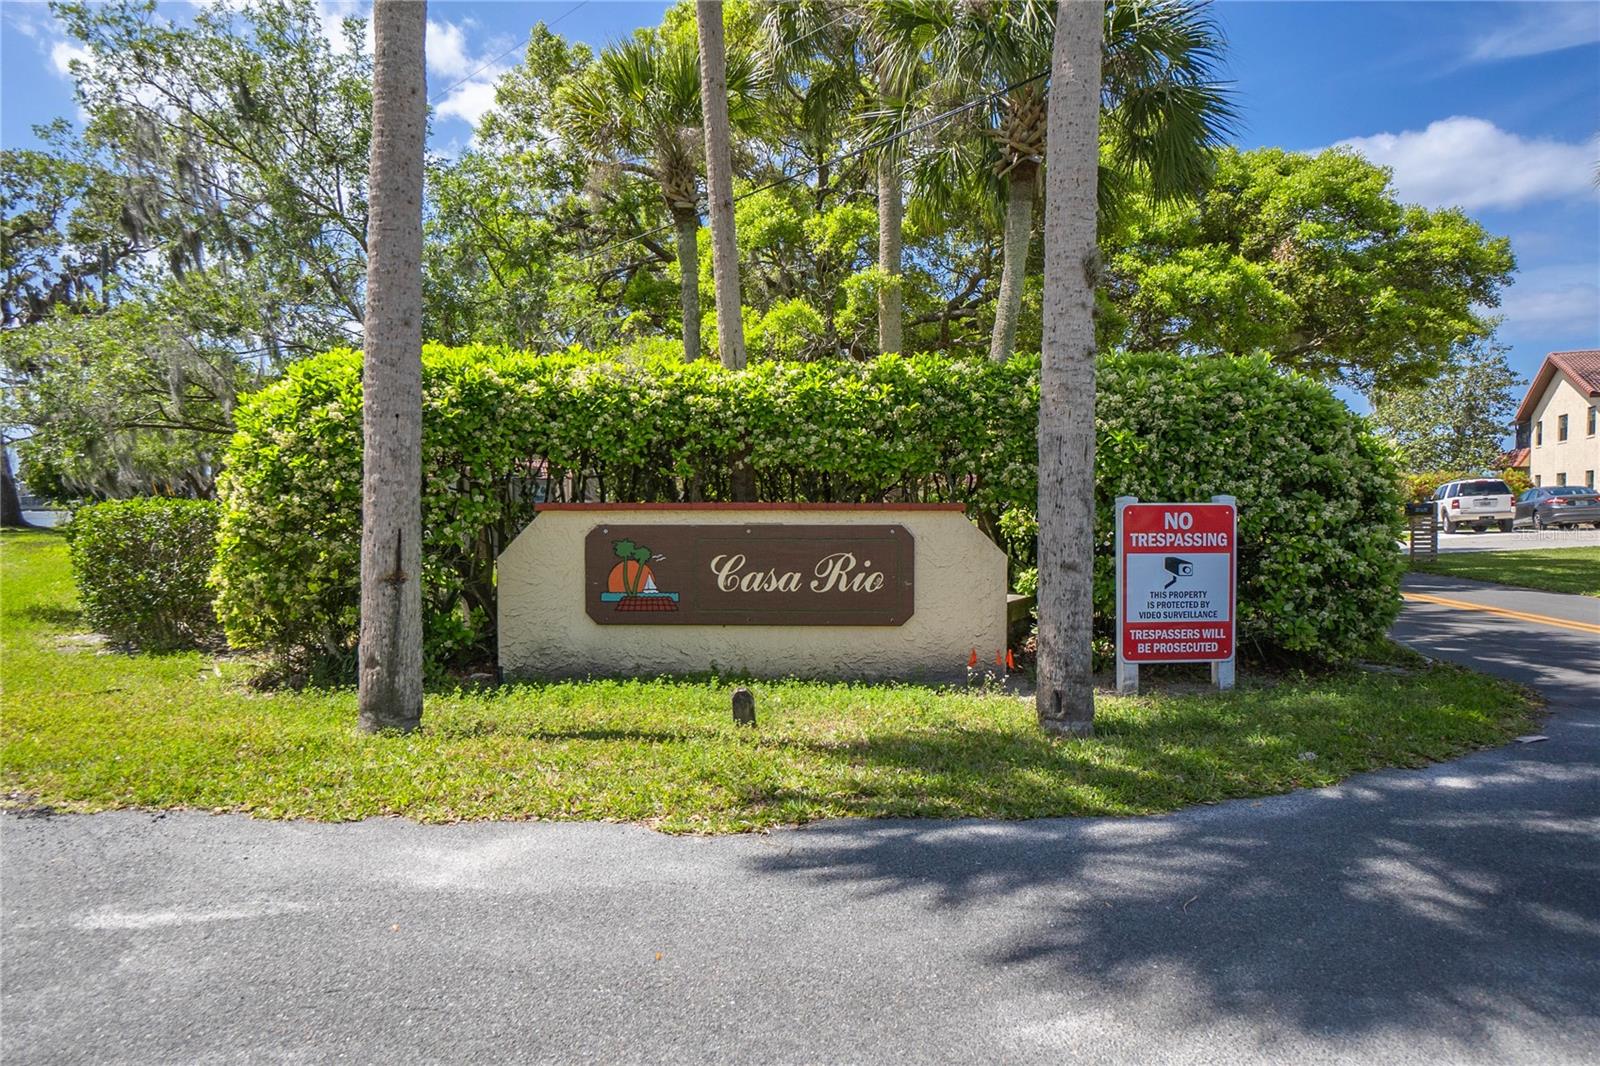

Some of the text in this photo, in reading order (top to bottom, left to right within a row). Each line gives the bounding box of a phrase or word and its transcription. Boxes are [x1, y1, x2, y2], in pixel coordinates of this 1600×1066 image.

[1164, 512, 1193, 530] NO
[1130, 533, 1228, 547] TRESPASSING
[710, 552, 884, 593] Casa Rio
[1150, 590, 1207, 599] THIS PROPERTY
[1147, 601, 1155, 609] IS
[1157, 601, 1199, 609] PROTECTED
[1139, 610, 1218, 619] VIDEO SURVEILLANCE
[1130, 629, 1226, 640] TRESPASSERS WILL
[1138, 642, 1219, 654] BE PROSECUTED
